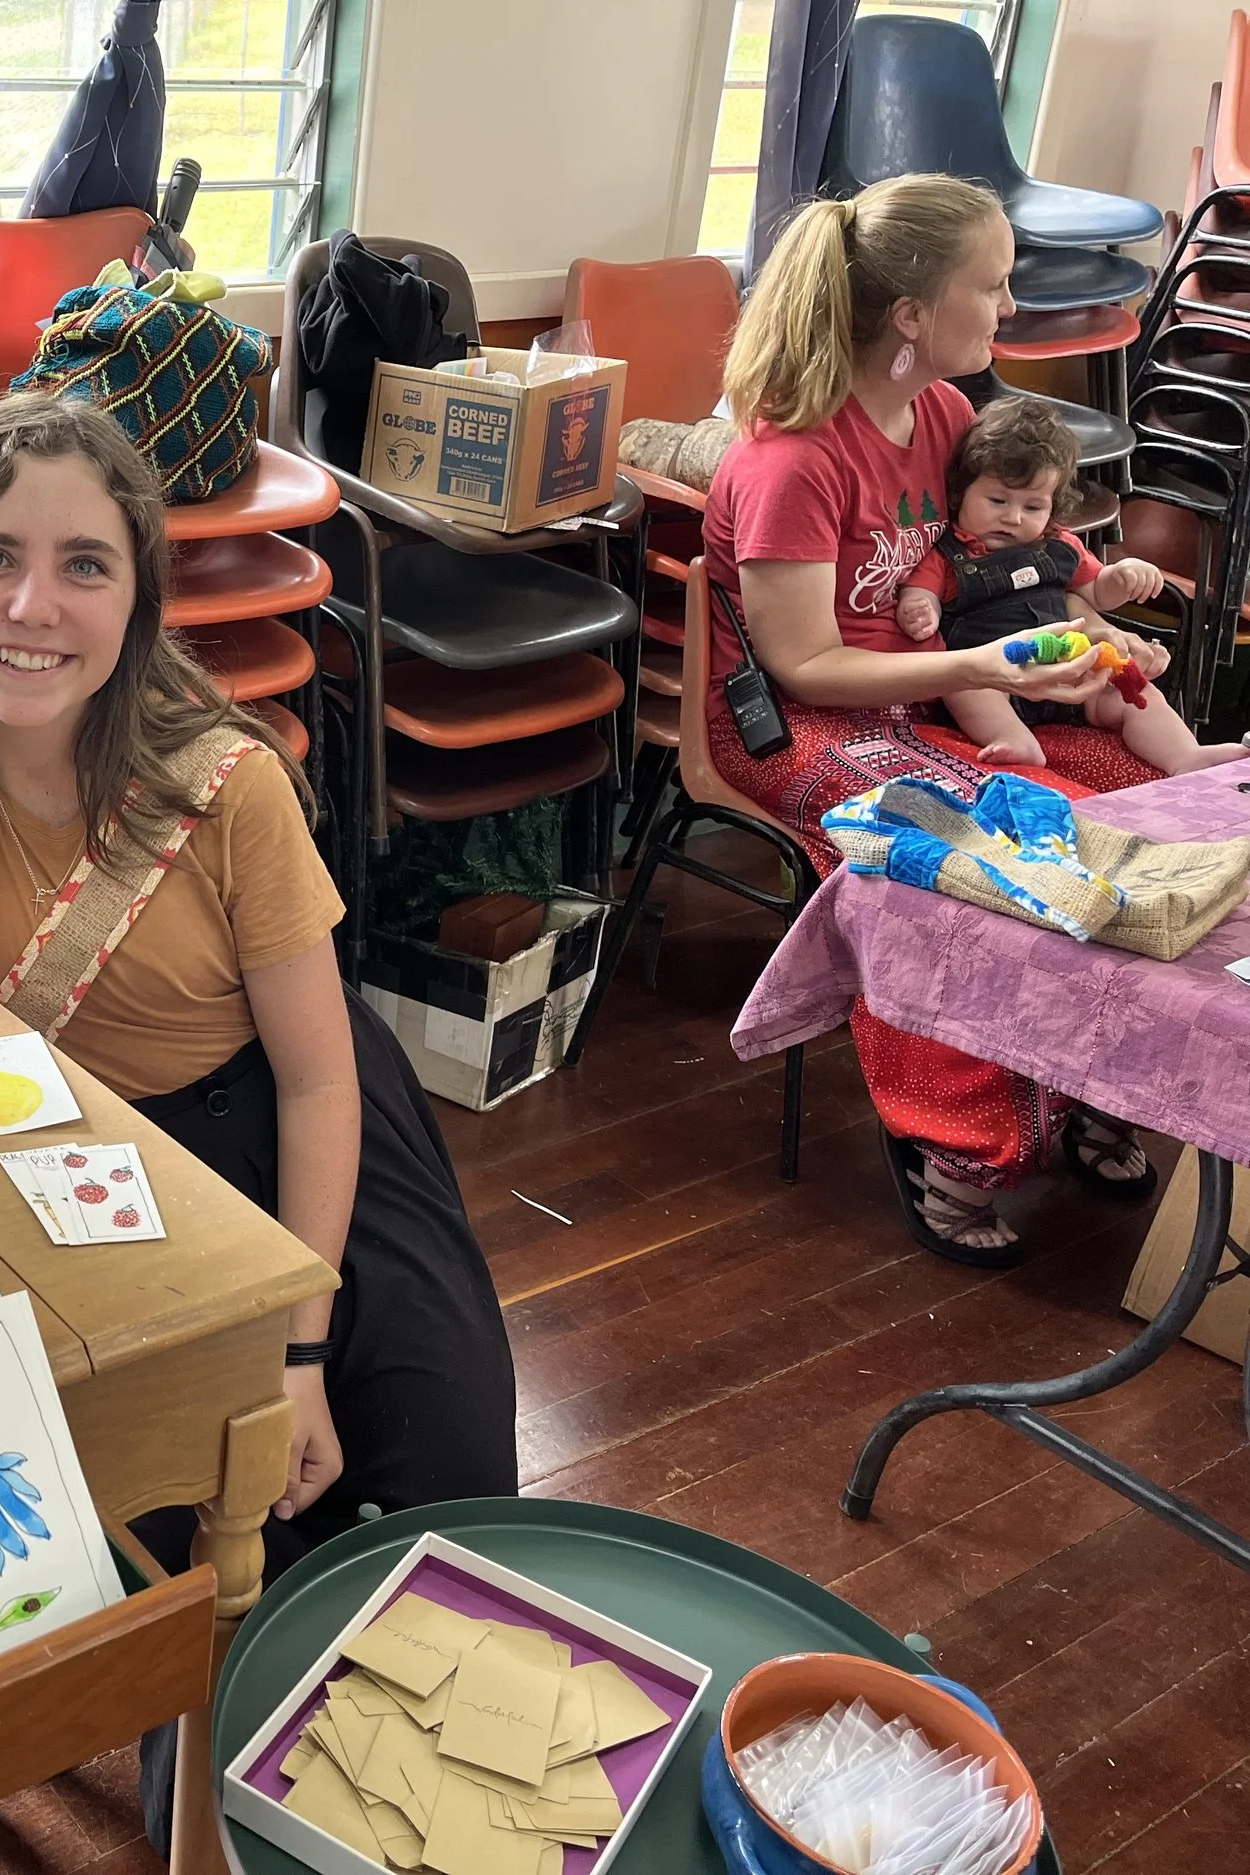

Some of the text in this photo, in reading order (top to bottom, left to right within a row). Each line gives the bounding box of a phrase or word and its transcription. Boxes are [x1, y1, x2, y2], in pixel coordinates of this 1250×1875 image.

[382, 412, 437, 436] GLOBE
[448, 405, 508, 427] CORNED
[447, 418, 507, 446] BEEF
[445, 447, 463, 458] 340g
[470, 452, 480, 460] 24
[481, 454, 503, 465] CANS
